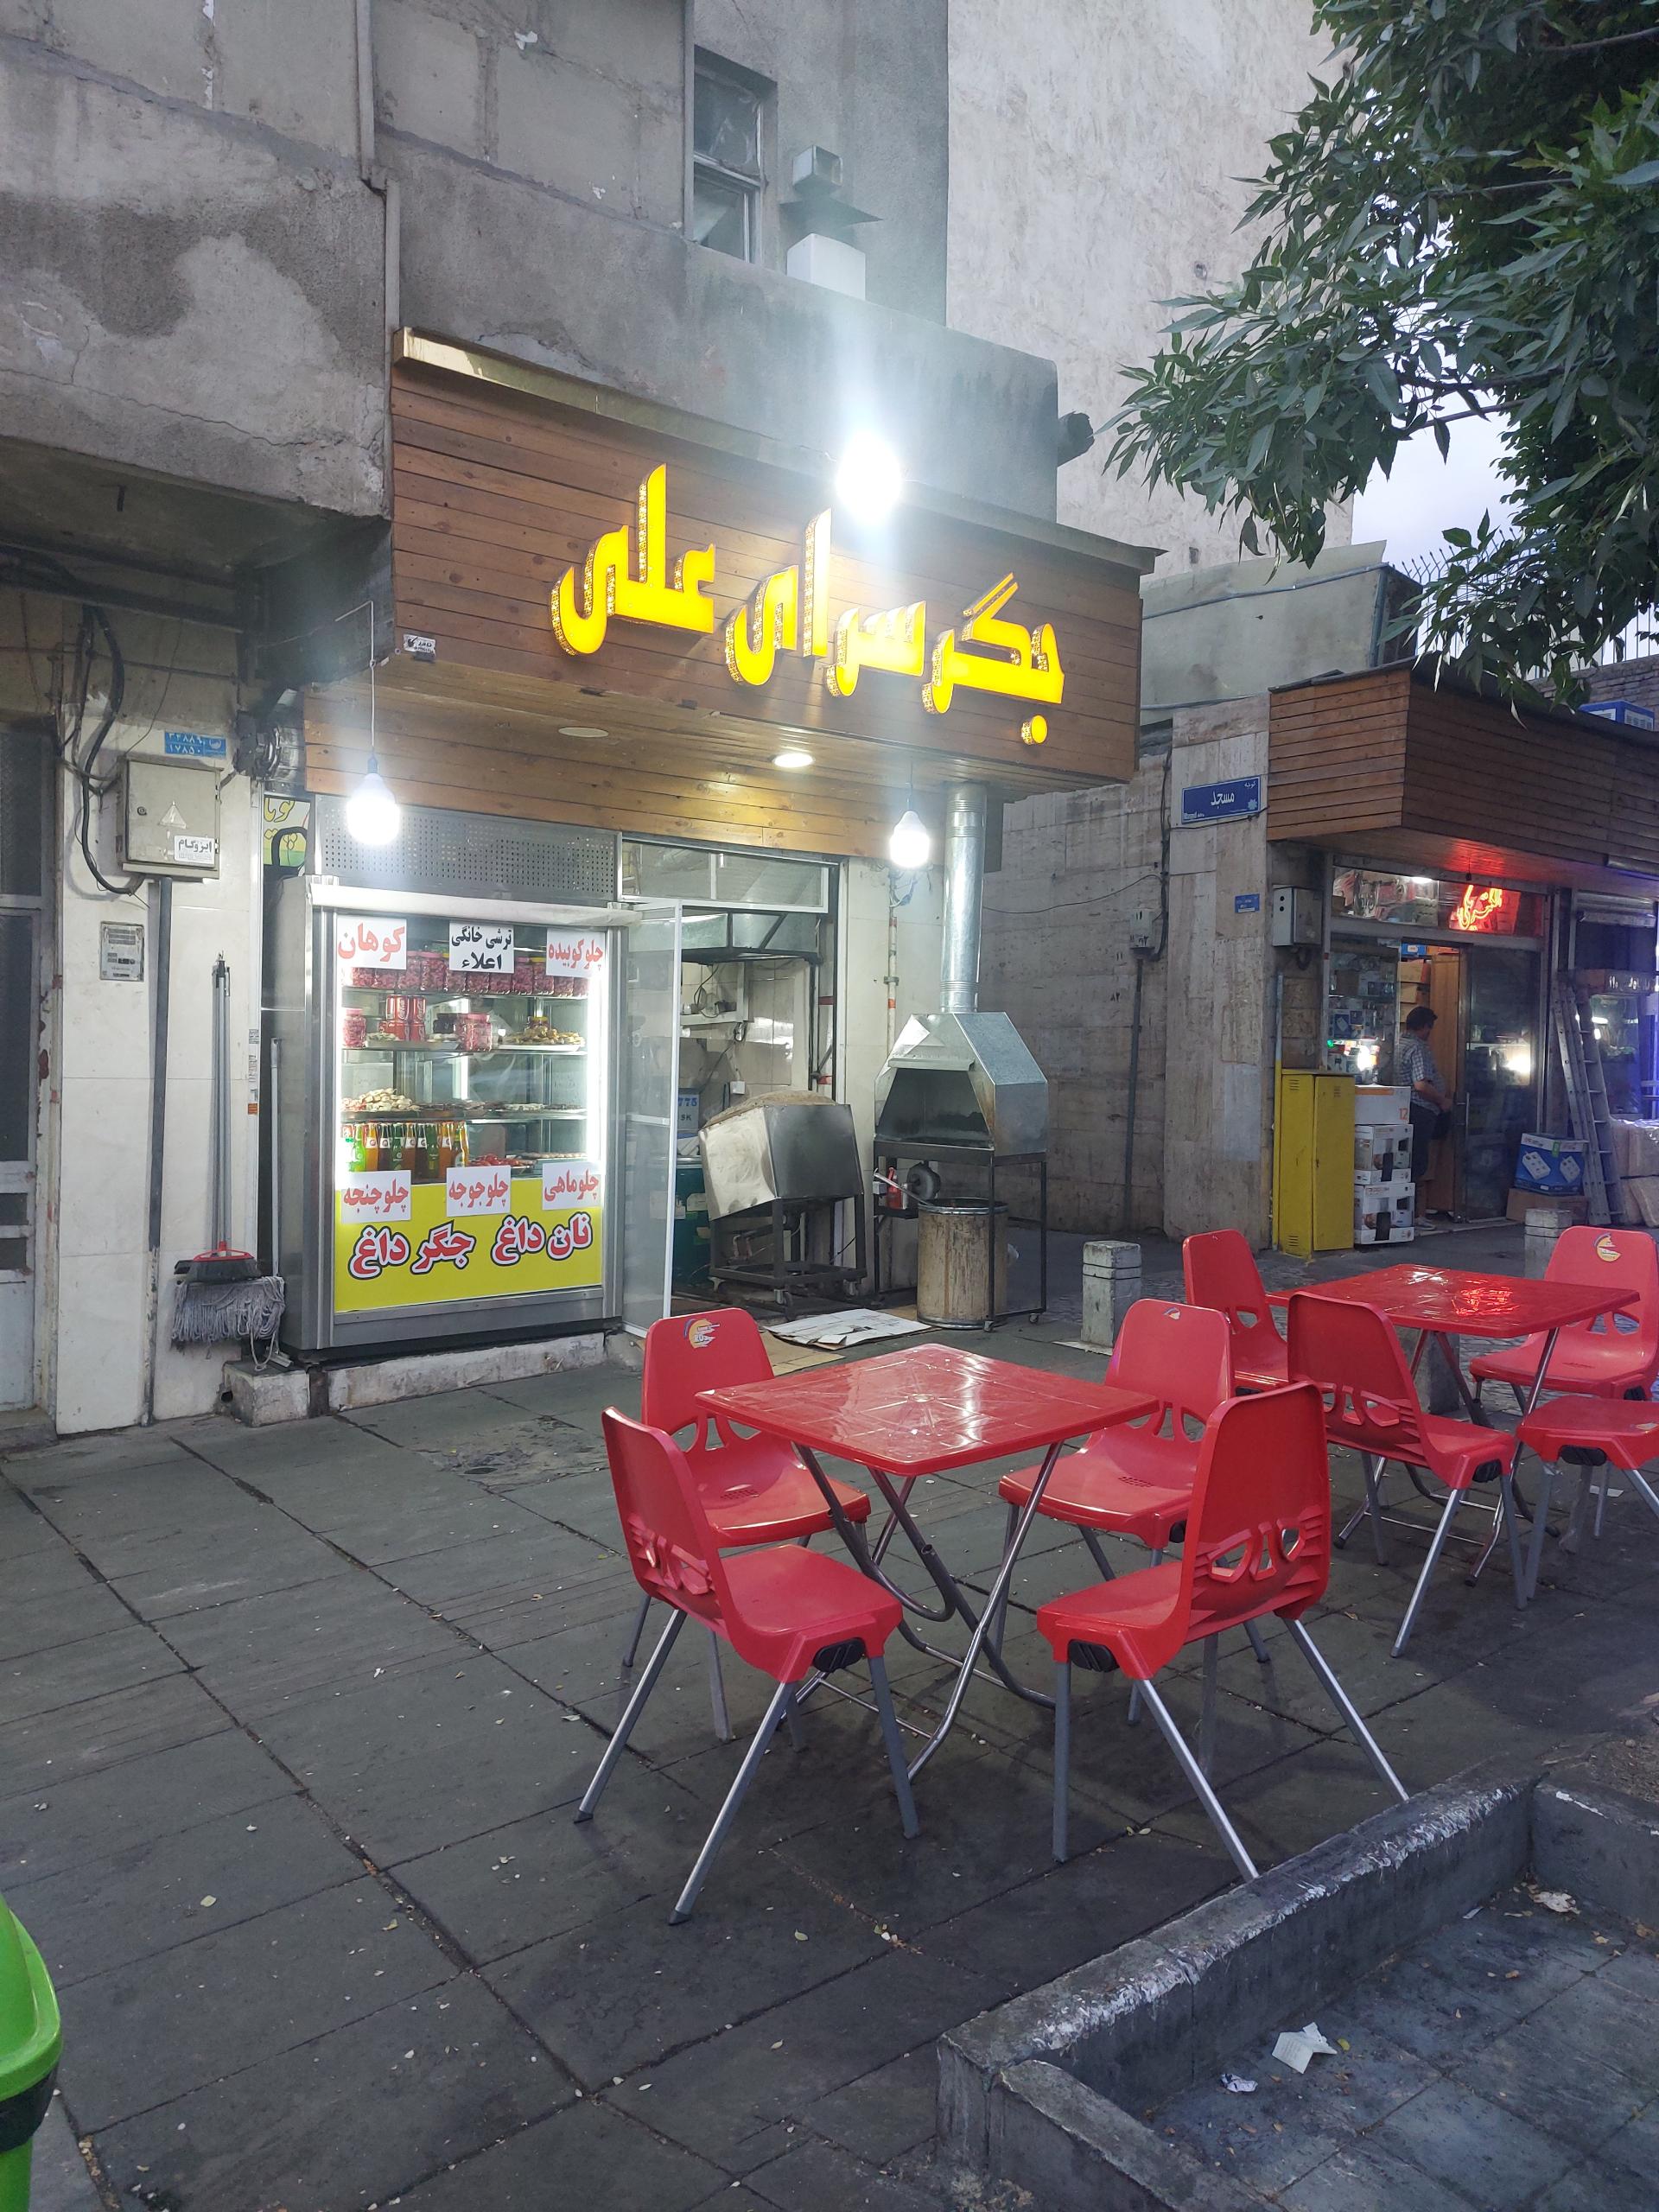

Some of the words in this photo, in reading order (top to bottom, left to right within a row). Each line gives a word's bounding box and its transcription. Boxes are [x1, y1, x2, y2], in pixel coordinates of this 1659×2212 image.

[550, 463, 715, 655] علی
[1211, 790, 1235, 810] مسجد
[338, 922, 405, 963] کوهان
[451, 925, 483, 947] خانگی
[486, 927, 512, 950] ترشی
[461, 951, 502, 970] اعلاء
[348, 1225, 411, 1280] داغ
[410, 1219, 476, 1274] جگر
[491, 1215, 546, 1267] داغ
[547, 1211, 594, 1261] نان
